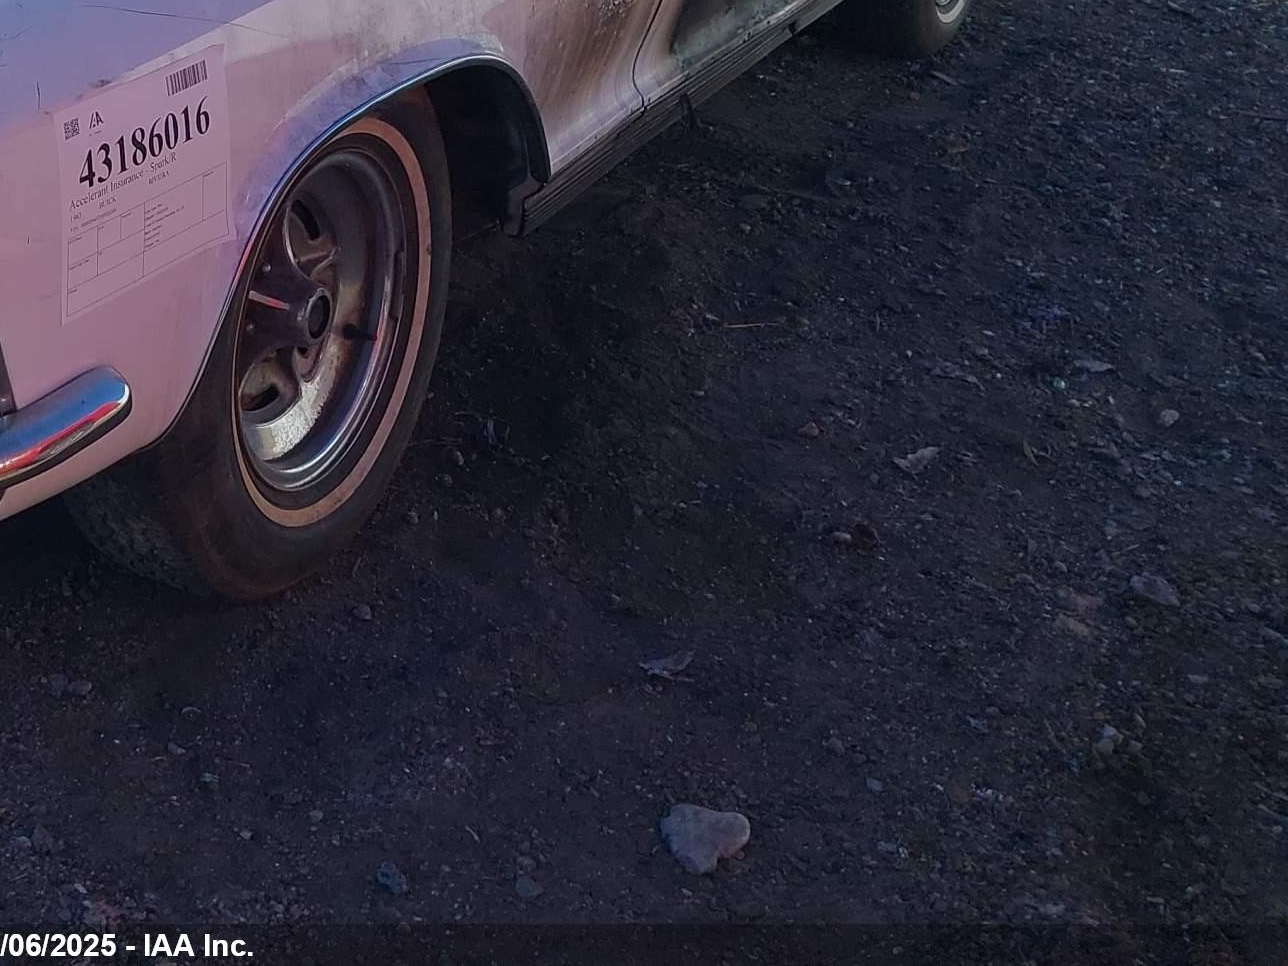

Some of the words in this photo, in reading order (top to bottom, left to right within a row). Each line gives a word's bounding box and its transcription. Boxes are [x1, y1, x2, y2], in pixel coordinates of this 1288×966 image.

[78, 96, 211, 188] 43186016
[69, 184, 109, 211] Accelerant
[110, 169, 144, 192] Insurance
[149, 151, 177, 172] Spark/R
